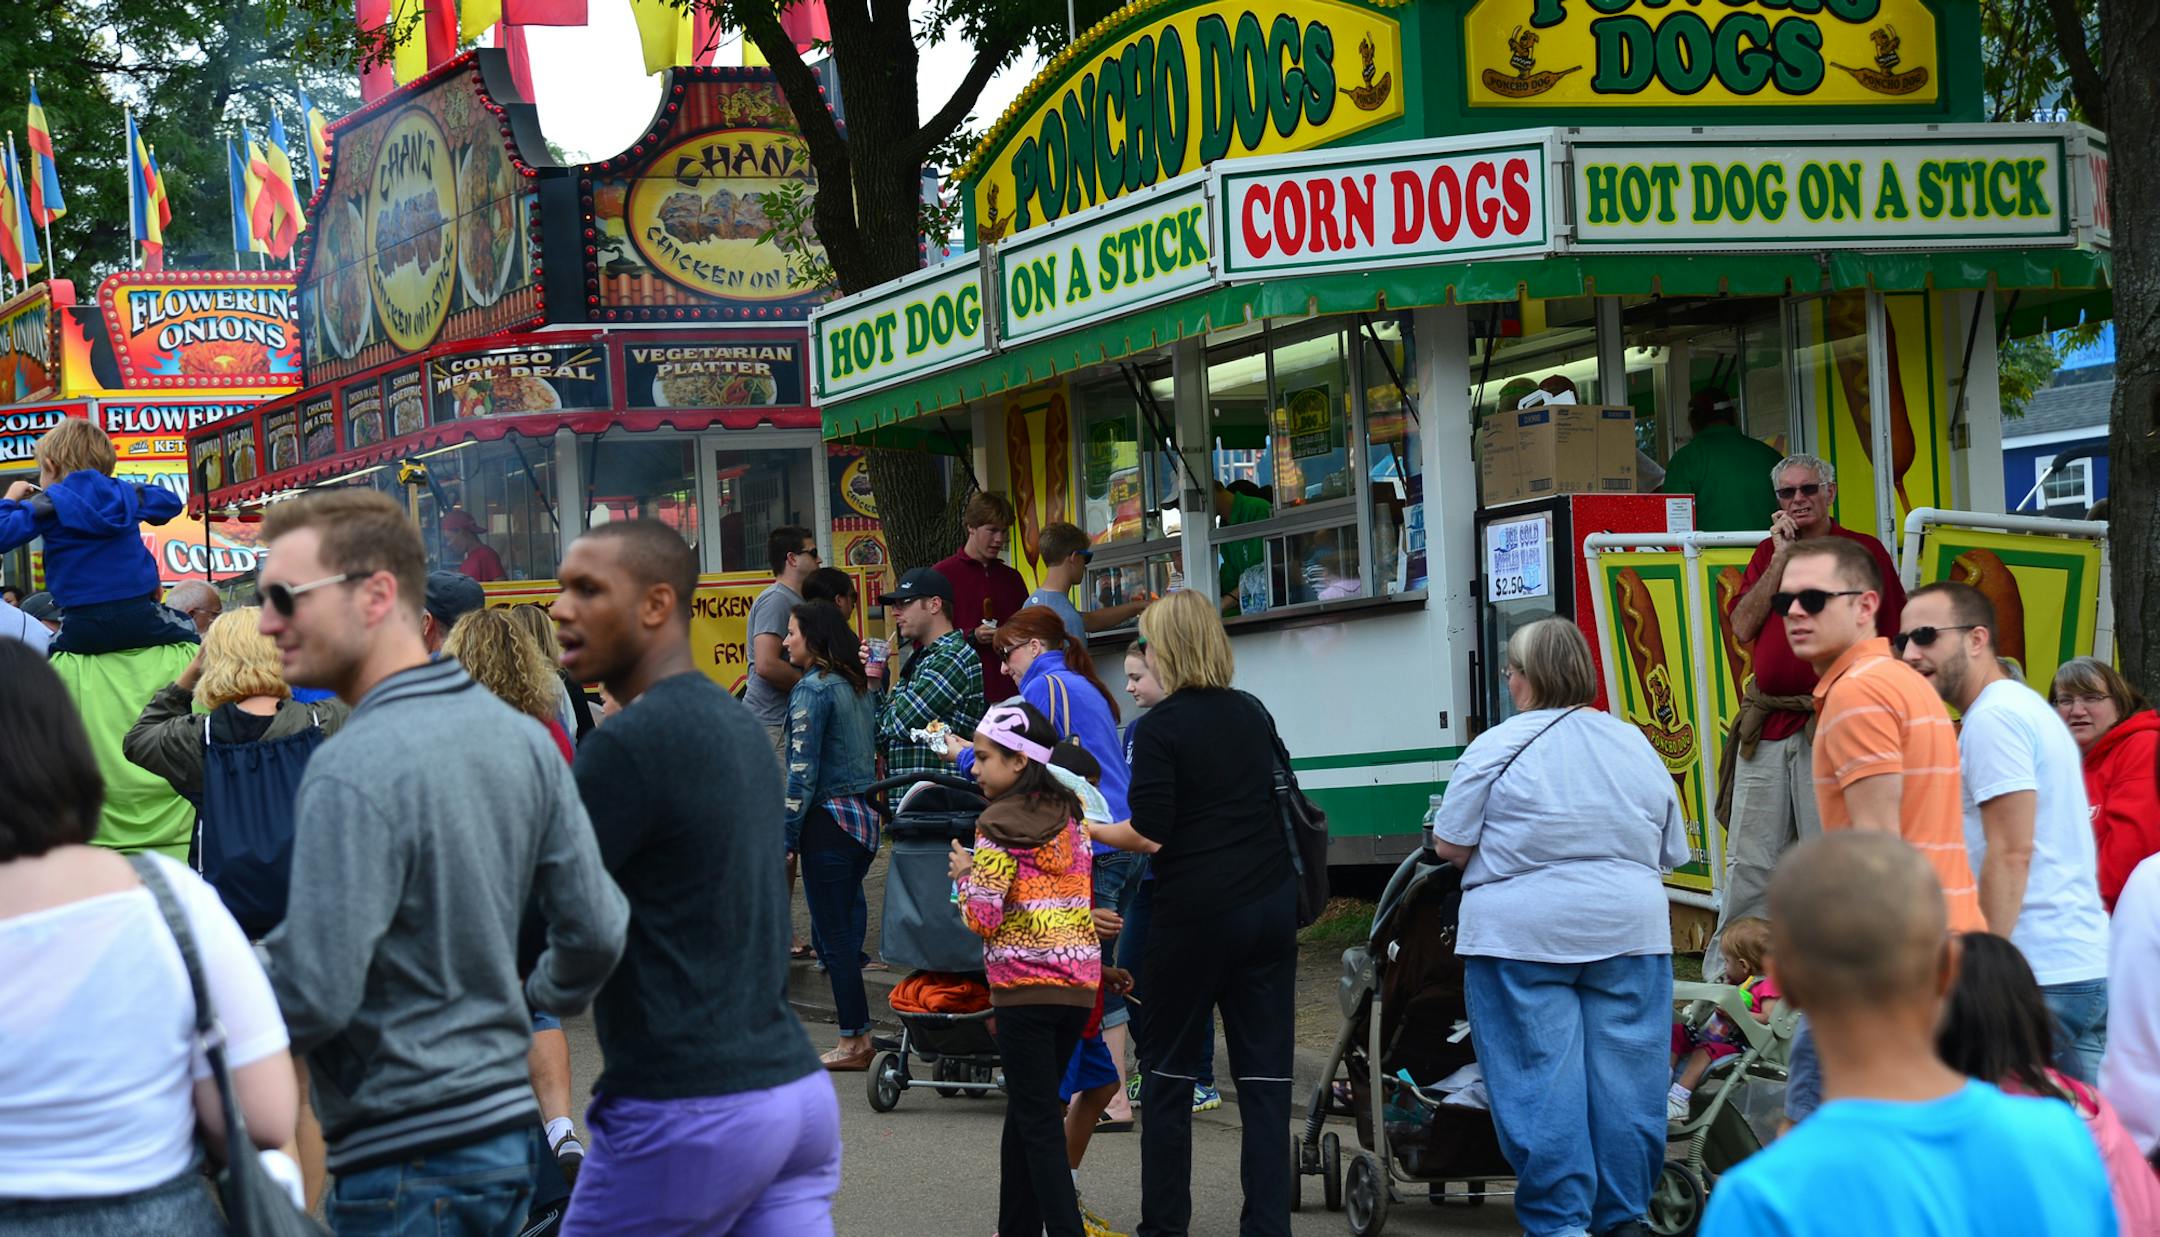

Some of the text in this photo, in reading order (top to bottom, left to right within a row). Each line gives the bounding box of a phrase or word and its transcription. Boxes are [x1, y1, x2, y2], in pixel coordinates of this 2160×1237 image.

[1590, 10, 1825, 95] DOGS
[1011, 10, 1336, 232] PONCHO DOGS
[1242, 158, 1531, 259] CORN DOGS
[1585, 162, 1681, 224] HOT
[1690, 162, 1789, 224] DOG
[1799, 161, 1863, 223] ON
[1874, 160, 1909, 221] A
[1918, 158, 2052, 219] STICK
[647, 226, 744, 287] CHICKEN
[750, 267, 780, 289] ON
[829, 204, 1209, 379] HOT DOG ON A STICK
[158, 315, 288, 350] ONIONS
[450, 352, 552, 374] COMBO
[632, 346, 793, 363] VEGETARIAN
[657, 360, 772, 377] PLATTER
[437, 365, 596, 395] MEAL DEAL
[165, 539, 257, 574] COLD
[1495, 575, 1524, 597] $2.50
